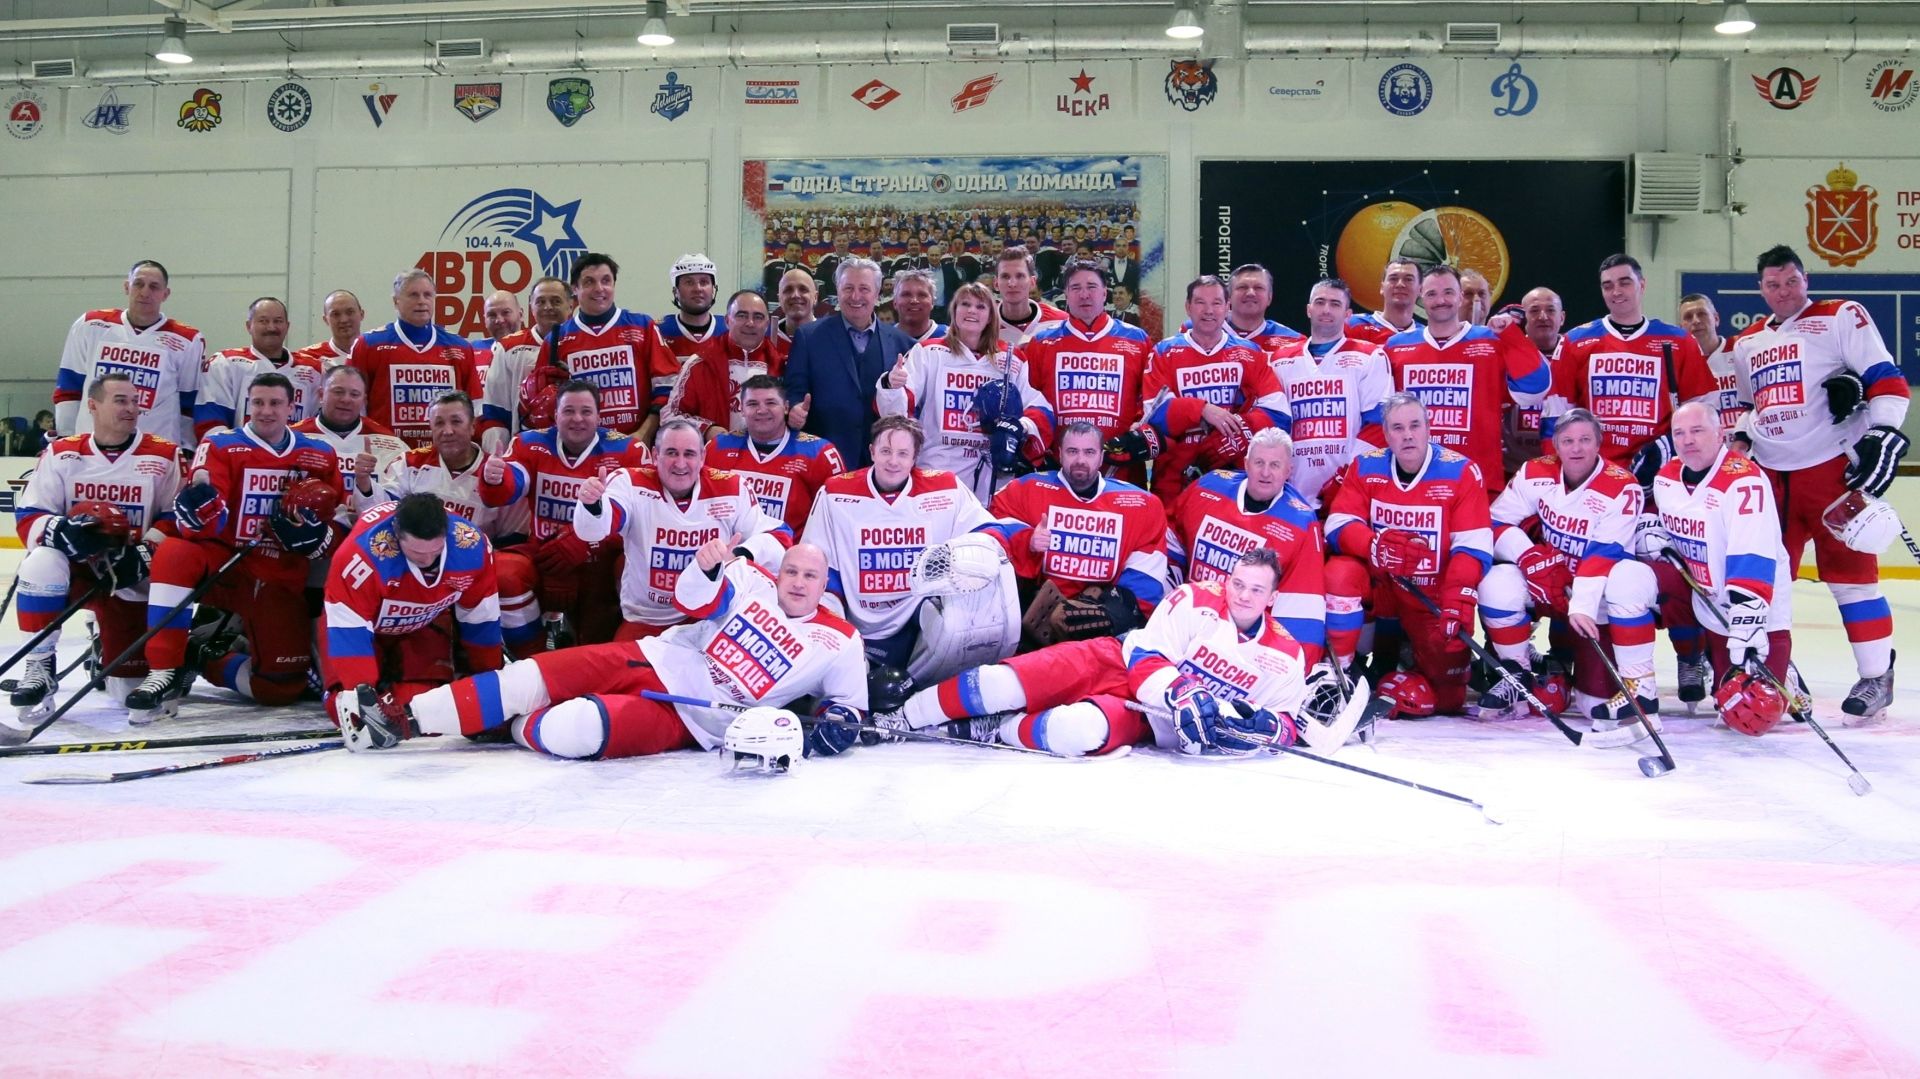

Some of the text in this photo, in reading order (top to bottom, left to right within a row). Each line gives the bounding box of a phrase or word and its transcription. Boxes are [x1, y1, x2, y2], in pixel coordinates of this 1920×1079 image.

[1270, 86, 1321, 96] Северсталь
[1057, 94, 1109, 116] ЦСКА
[790, 176, 929, 194] ОДНА СТРАНА
[955, 173, 1116, 193] ОДНА КОМАНДА
[465, 236, 502, 248] 104.4
[101, 346, 160, 368] РОССИЯ
[573, 351, 628, 372] РОССИЯ
[1062, 356, 1118, 372] РОССИЯ
[1751, 344, 1798, 372] РОССИЯ
[1595, 358, 1655, 376] РОССИЯ
[1759, 364, 1801, 388] МОЁМ
[396, 370, 450, 383] РОССИЯ
[1060, 374, 1118, 391] В МОЁМ
[1183, 368, 1238, 386] РОССИЯ
[1409, 369, 1466, 385] РОССИЯ
[396, 389, 405, 402] В
[1291, 380, 1343, 399] РОССИЯ
[1592, 378, 1656, 398] В МОЁМ
[945, 394, 955, 408] В
[1062, 393, 1115, 409] СЕРДЦЕ
[1300, 399, 1345, 418] МОЁМ
[1596, 400, 1651, 417] СЕРДЦЕ
[1098, 417, 1112, 428] 2018
[1295, 421, 1342, 440] СЕРДЦЕ
[1444, 434, 1460, 444] 2018
[1325, 444, 1340, 454] 2018
[75, 482, 142, 503] РОССИЯ
[1036, 482, 1060, 491] CCM
[1200, 491, 1221, 502] CCM
[1737, 485, 1764, 515] 27
[245, 498, 257, 514] В
[539, 500, 549, 516] В
[1054, 512, 1116, 535] РОССИЯ
[1376, 506, 1435, 528] РОССИЯ
[1539, 499, 1589, 536] РОССИЯ
[1662, 513, 1705, 538] РОССИЯ
[656, 528, 719, 547] РОССИЯ
[861, 527, 925, 546] РОССИЯ
[1202, 522, 1258, 553] РОССИЯ
[1050, 534, 1116, 558] В МОЁМ
[1195, 543, 1206, 560] В
[652, 552, 664, 568] В
[860, 552, 874, 570] В
[1050, 556, 1109, 578] СЕРДЦЕ
[1412, 576, 1428, 585] 2018
[380, 618, 394, 627] В
[743, 601, 804, 660] РОССИЯ
[723, 618, 739, 636] В
[736, 631, 789, 678] МОЁМ
[712, 638, 770, 693] СЕРДЦЕ
[1192, 645, 1258, 690] РОССИЯ
[1495, 666, 1548, 712] FISCHER
[58, 741, 148, 754] CCM
